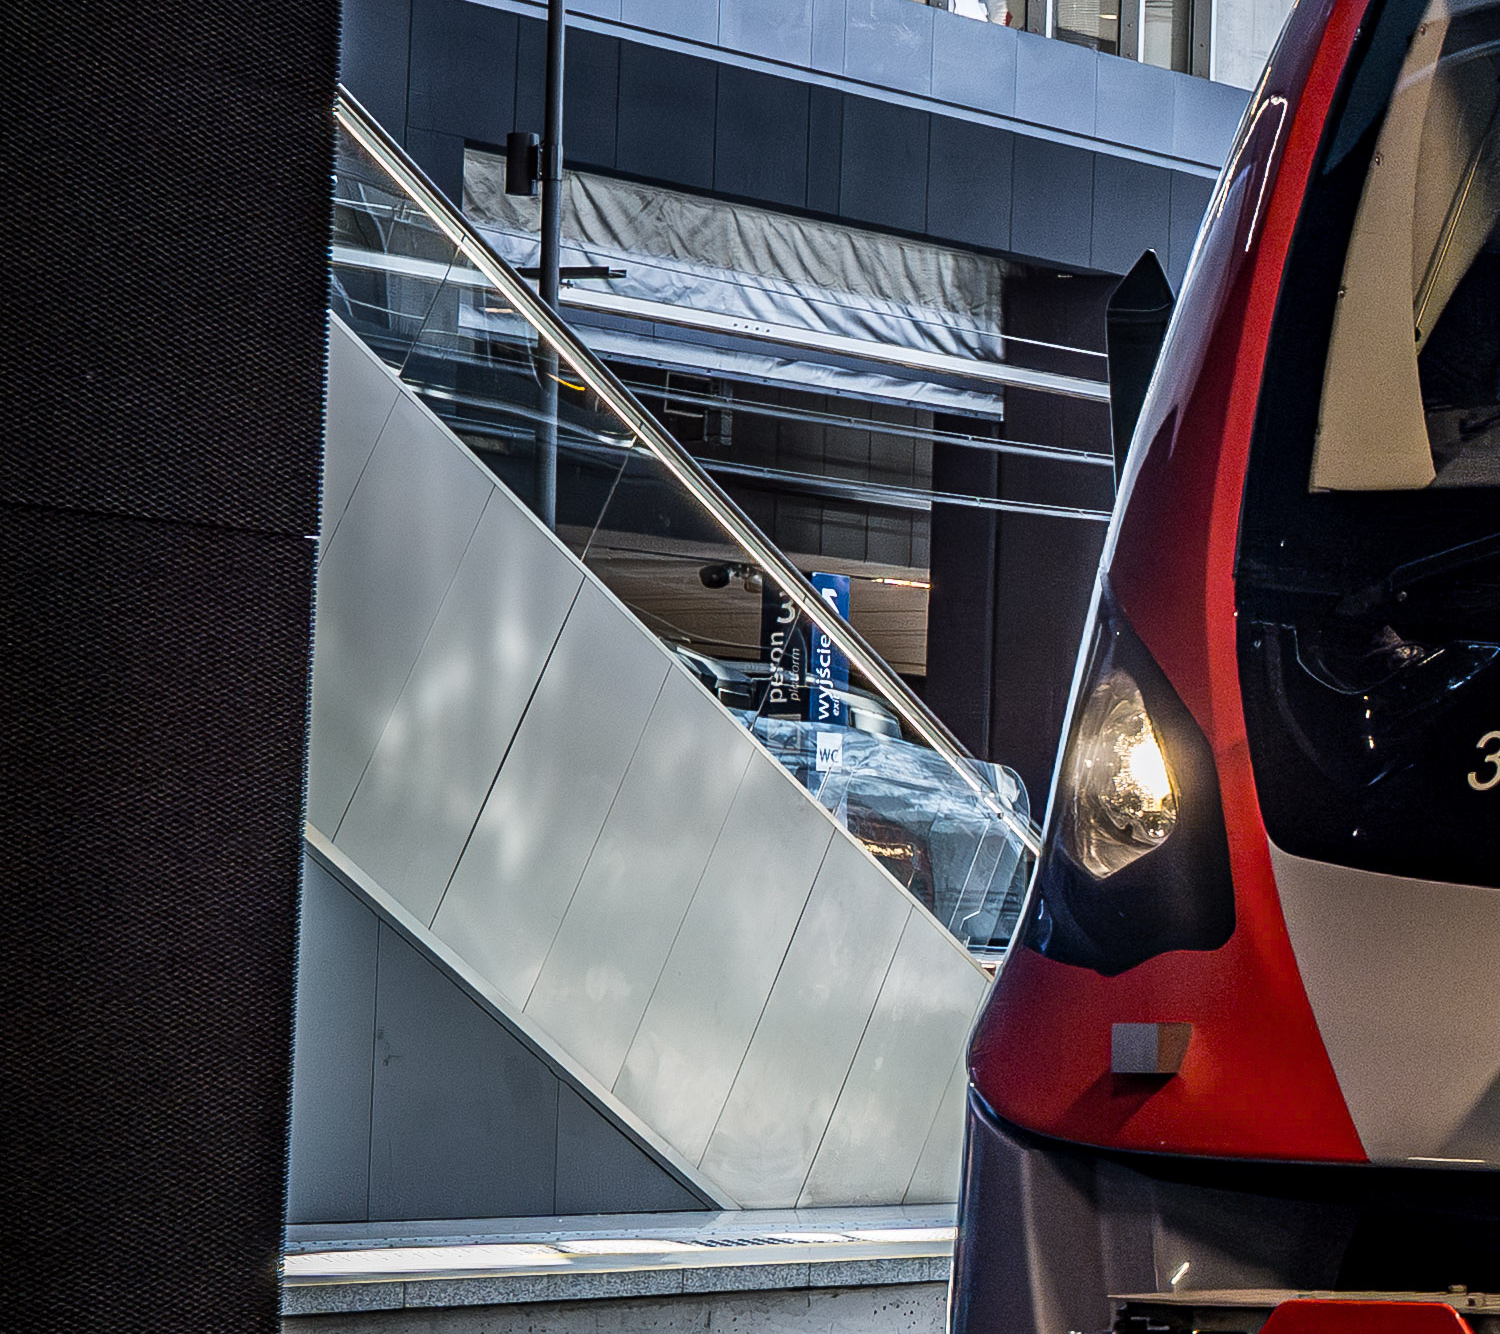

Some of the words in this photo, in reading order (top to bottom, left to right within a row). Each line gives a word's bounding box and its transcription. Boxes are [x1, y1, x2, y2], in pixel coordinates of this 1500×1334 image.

[769, 631, 788, 704] peron
[815, 634, 834, 720] wyjście
[819, 748, 840, 763] WC
